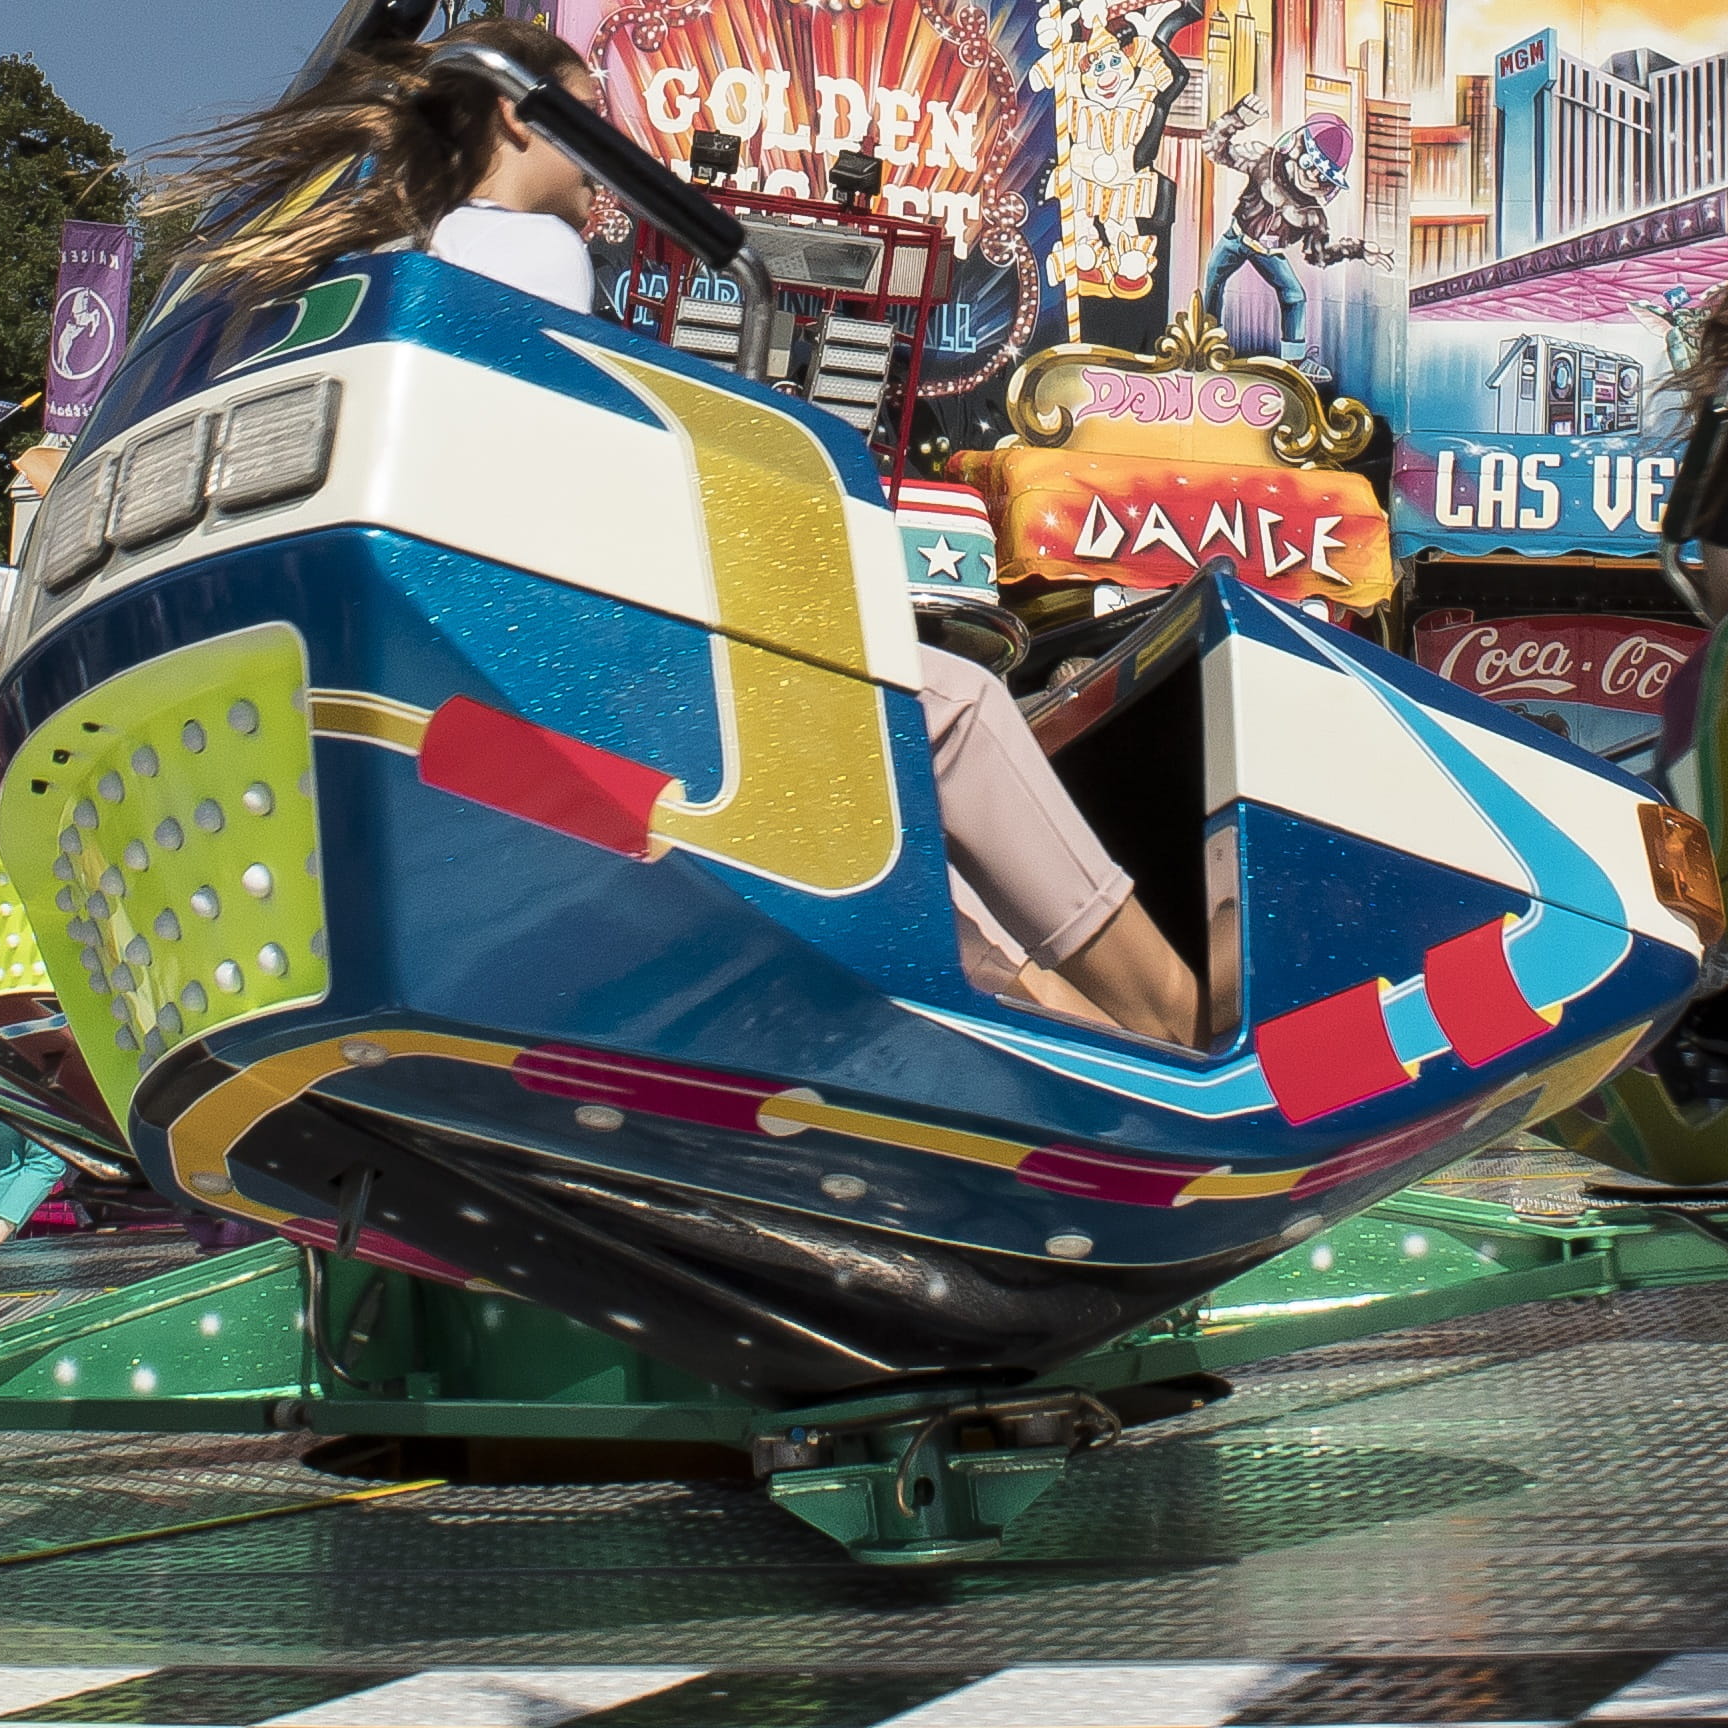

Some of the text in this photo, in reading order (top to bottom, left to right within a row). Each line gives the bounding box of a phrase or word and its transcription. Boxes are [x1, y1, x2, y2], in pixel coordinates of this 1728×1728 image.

[1498, 38, 1545, 78] MGM
[642, 65, 979, 172] GOLDEN
[1073, 368, 1285, 428] DANCE
[1434, 450, 1678, 534] LAS VE
[1073, 494, 1354, 587] DANCE
